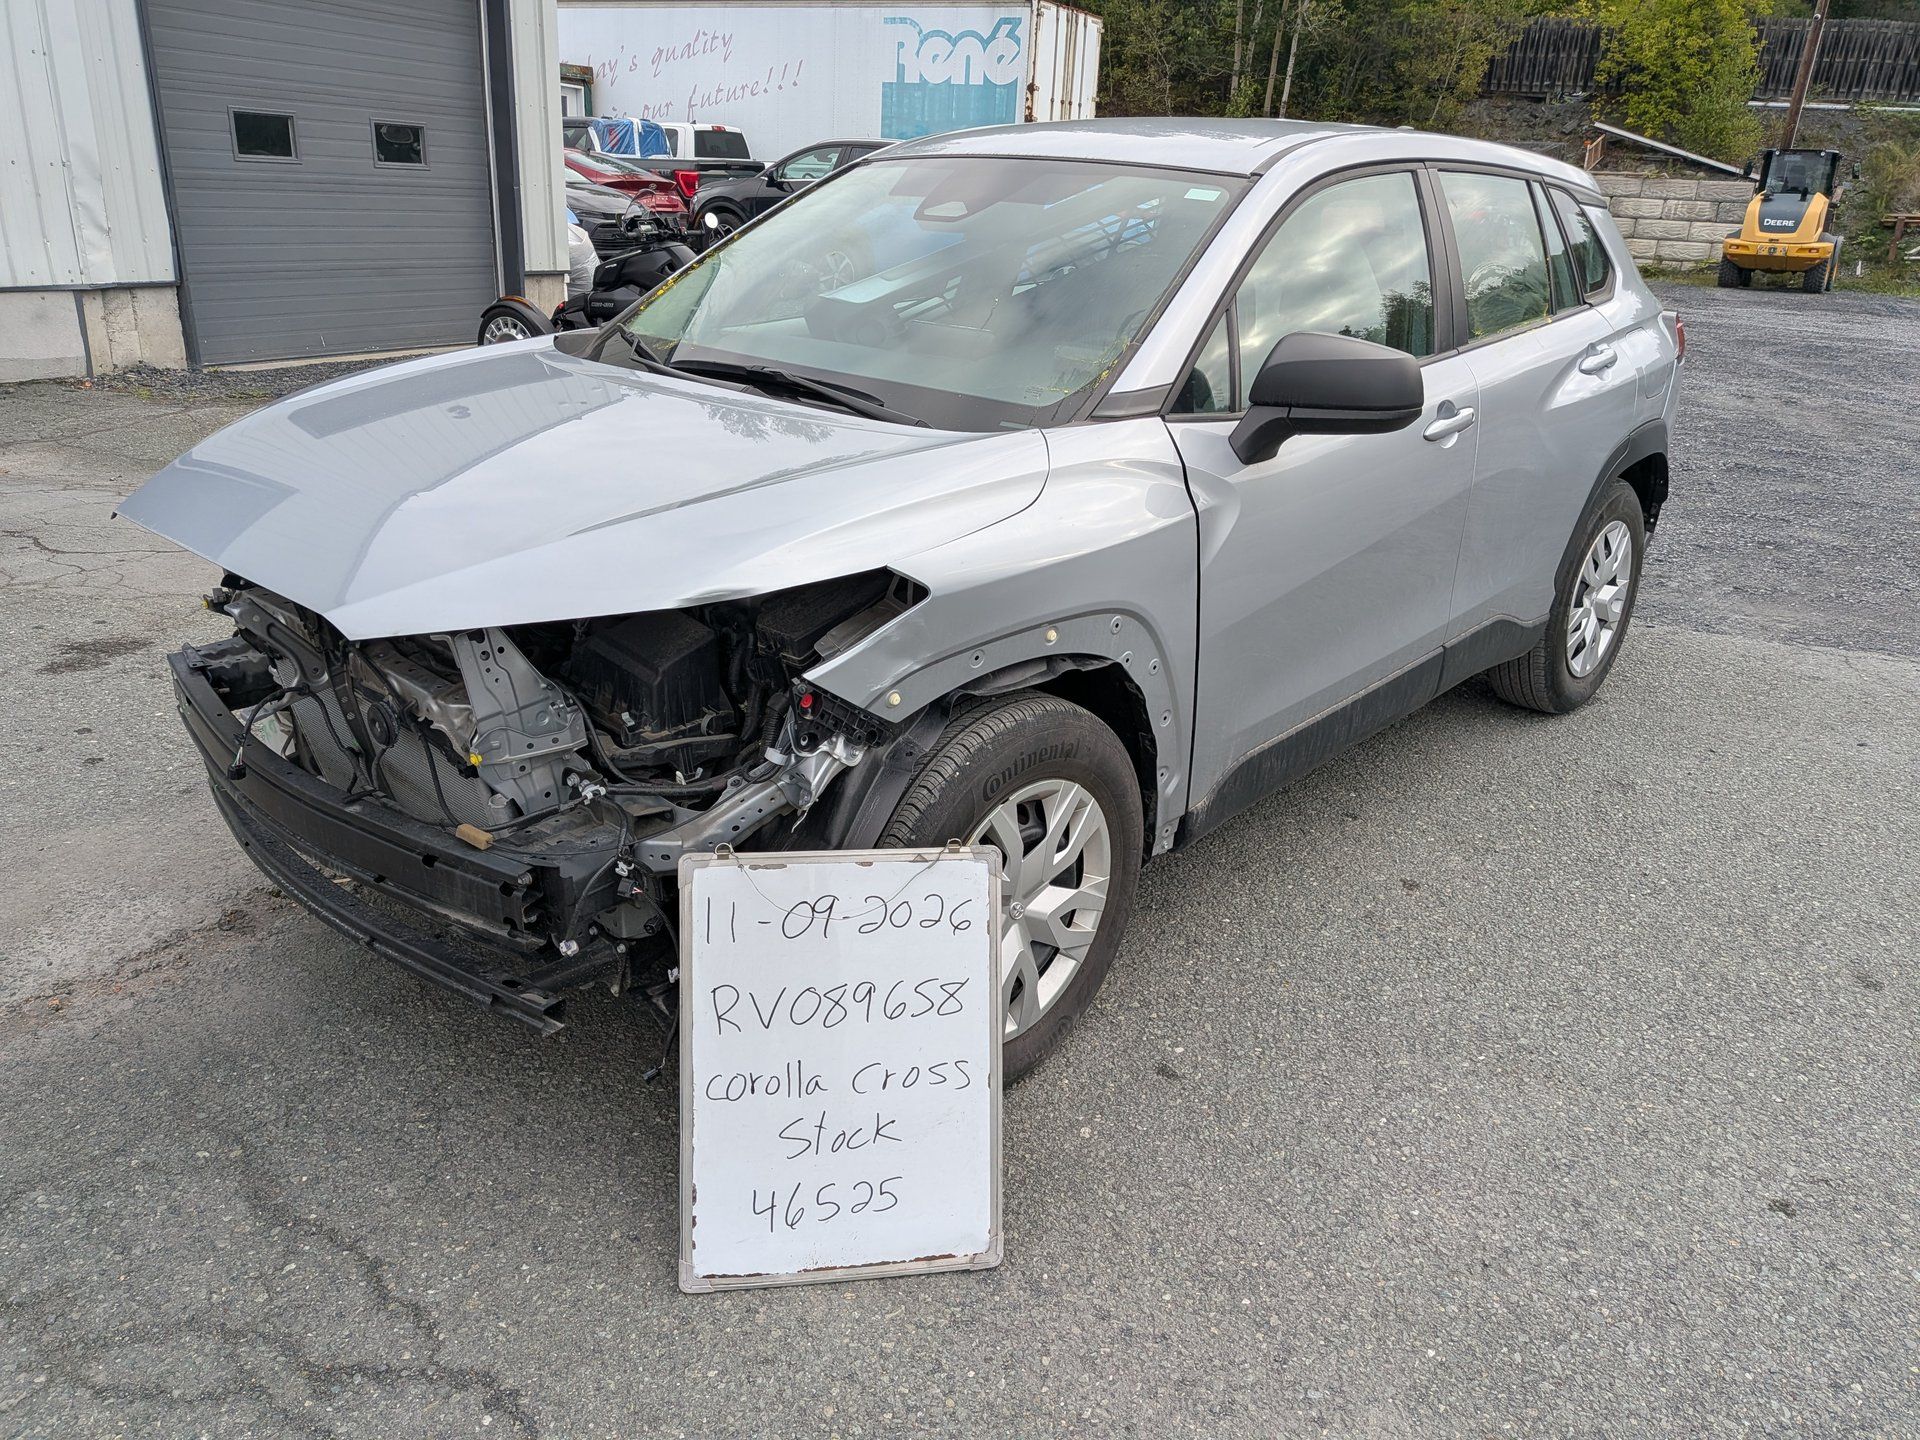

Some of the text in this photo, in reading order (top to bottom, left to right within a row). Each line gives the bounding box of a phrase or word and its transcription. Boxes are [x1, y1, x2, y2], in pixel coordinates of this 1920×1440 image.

[651, 29, 733, 78] quality
[884, 17, 1022, 85] René
[642, 59, 804, 121] our future!!!
[1763, 218, 1796, 227] DEERE
[983, 737, 1082, 802] Continental
[703, 893, 973, 945] 11-09-2026
[710, 977, 971, 1037] RV089658
[751, 1176, 904, 1234] 46525
